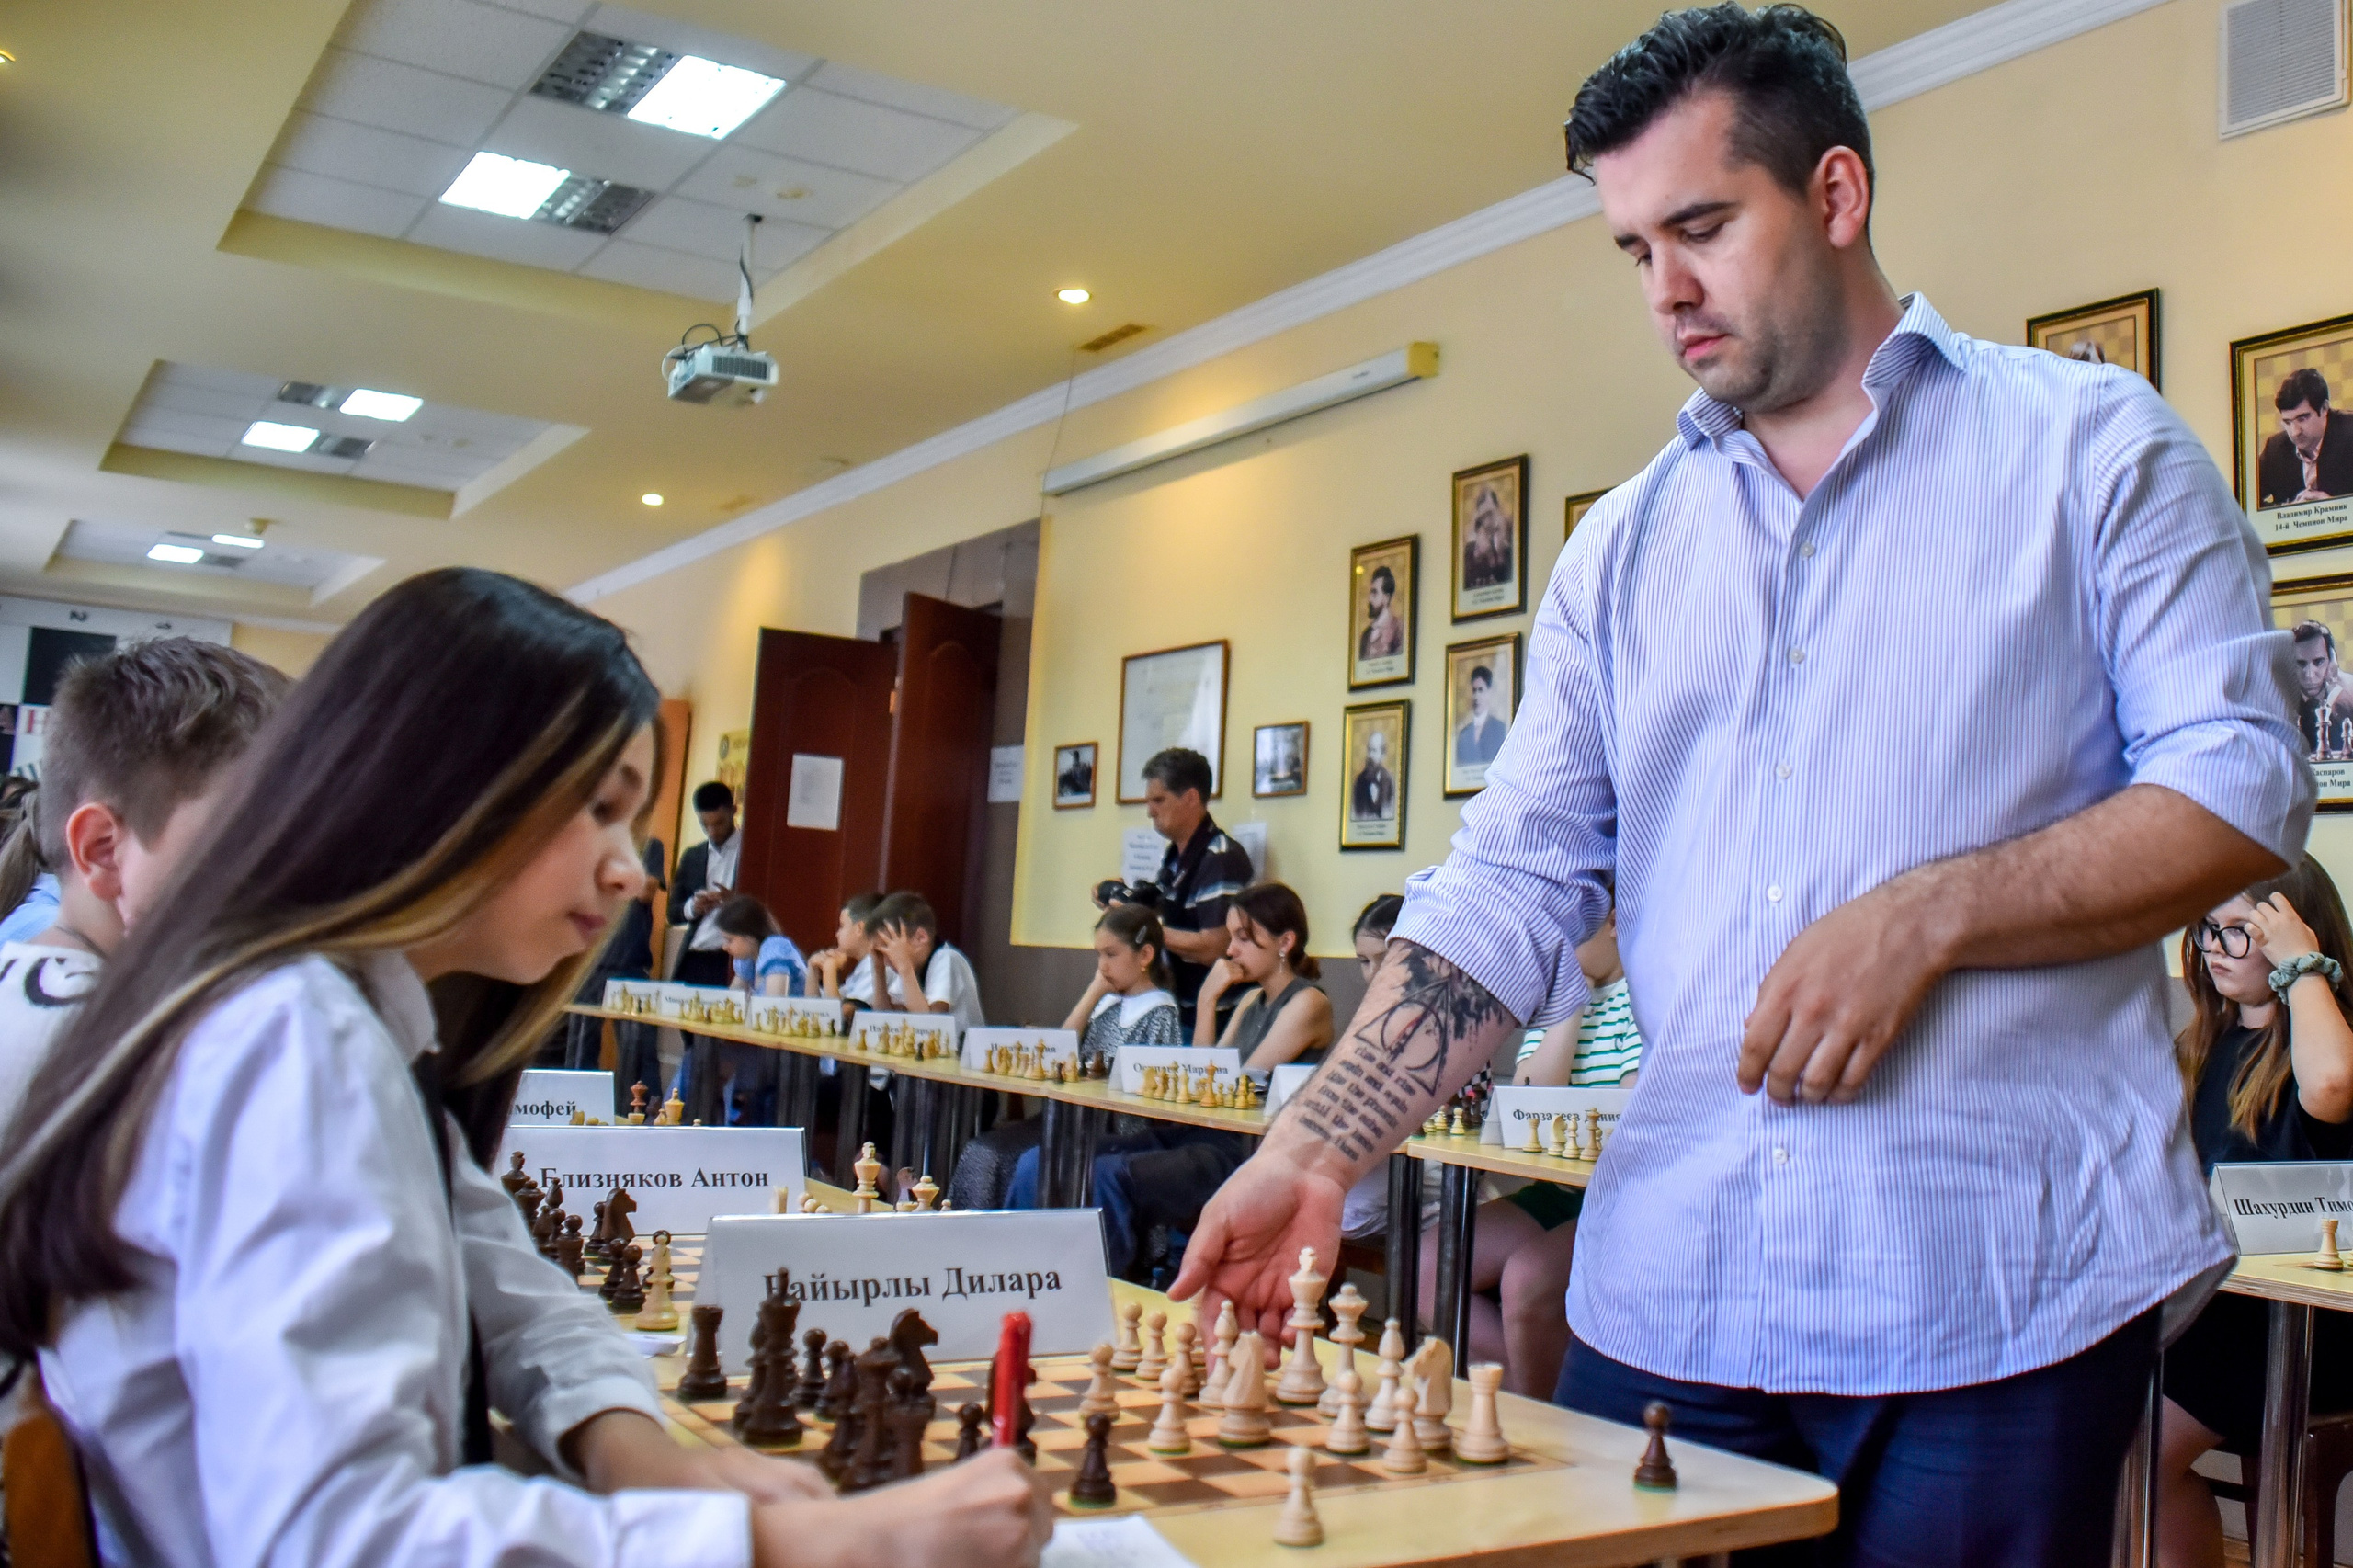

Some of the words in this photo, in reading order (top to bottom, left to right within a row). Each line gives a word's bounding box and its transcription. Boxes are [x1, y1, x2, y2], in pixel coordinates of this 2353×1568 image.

[2277, 508, 2312, 519] Владимир
[2313, 504, 2348, 515] Крамник
[2275, 523, 2290, 531] 14-й
[2293, 518, 2325, 528] Чемпион
[2326, 515, 2348, 524] Мира
[2330, 778, 2351, 789] Мира
[511, 1100, 576, 1119] мофей
[1513, 1109, 1580, 1122] Фарзаеев
[539, 1167, 683, 1190] Близняков
[690, 1166, 768, 1188] Антон
[2234, 1199, 2315, 1219] Шахурдин
[941, 1267, 1063, 1301] Дилара
